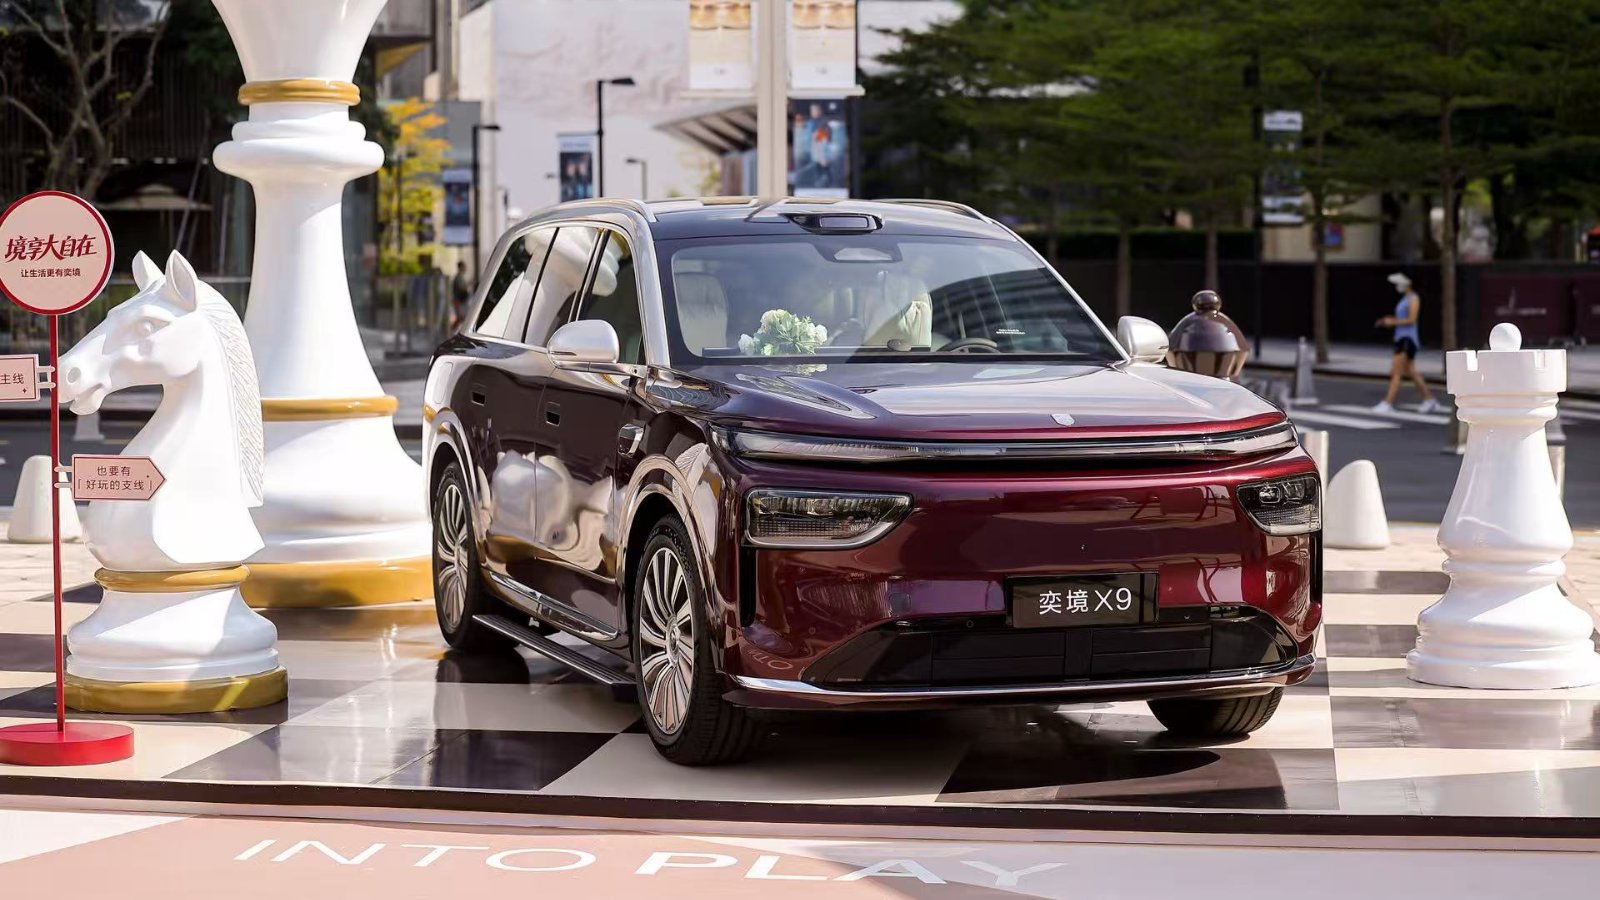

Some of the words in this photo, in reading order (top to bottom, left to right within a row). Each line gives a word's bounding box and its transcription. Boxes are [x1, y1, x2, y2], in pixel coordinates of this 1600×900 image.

[5, 233, 97, 263] 境享大自在
[21, 268, 81, 278] 让生活更有奕境
[97, 466, 131, 476] 也要有
[233, 839, 597, 872] INTO
[634, 851, 1068, 886] PLAY
